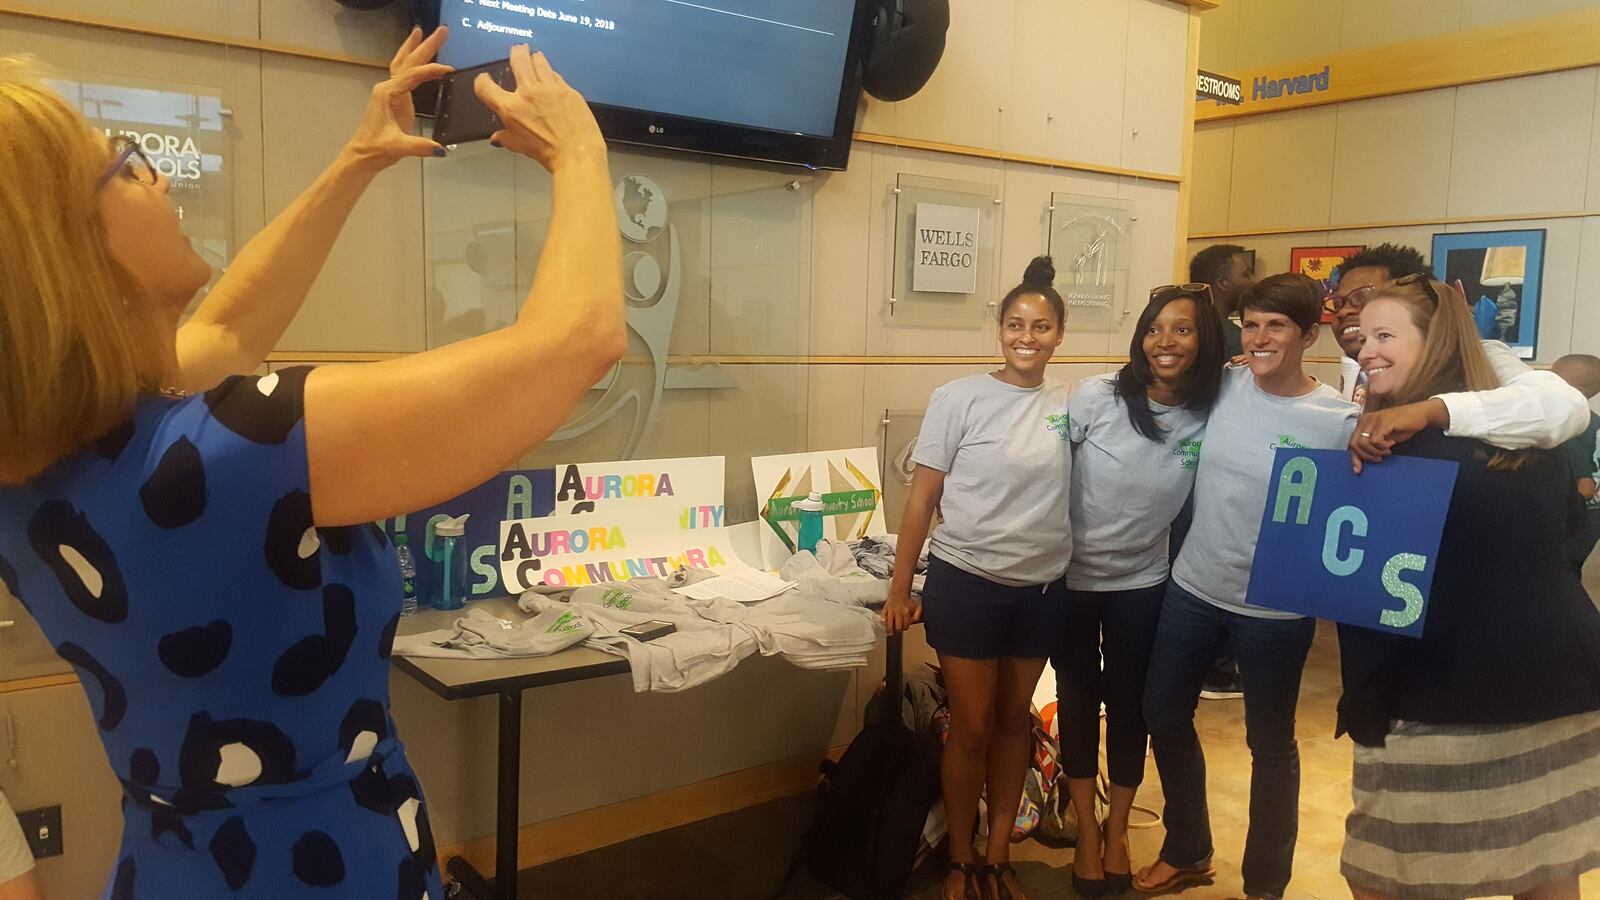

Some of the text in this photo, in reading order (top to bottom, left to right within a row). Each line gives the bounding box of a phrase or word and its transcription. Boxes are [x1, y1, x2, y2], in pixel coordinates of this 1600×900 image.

[461, 17, 533, 38] C. Adjournment
[479, 0, 615, 31] Next Meeting Date June 19, 2018
[1196, 75, 1241, 102] RESTROOMS
[1251, 65, 1330, 102] Harvard
[920, 228, 974, 248] WELLS
[920, 250, 972, 268] FARGO
[557, 464, 674, 502] AURORA
[850, 490, 875, 509] School
[501, 522, 627, 562] AURORA
